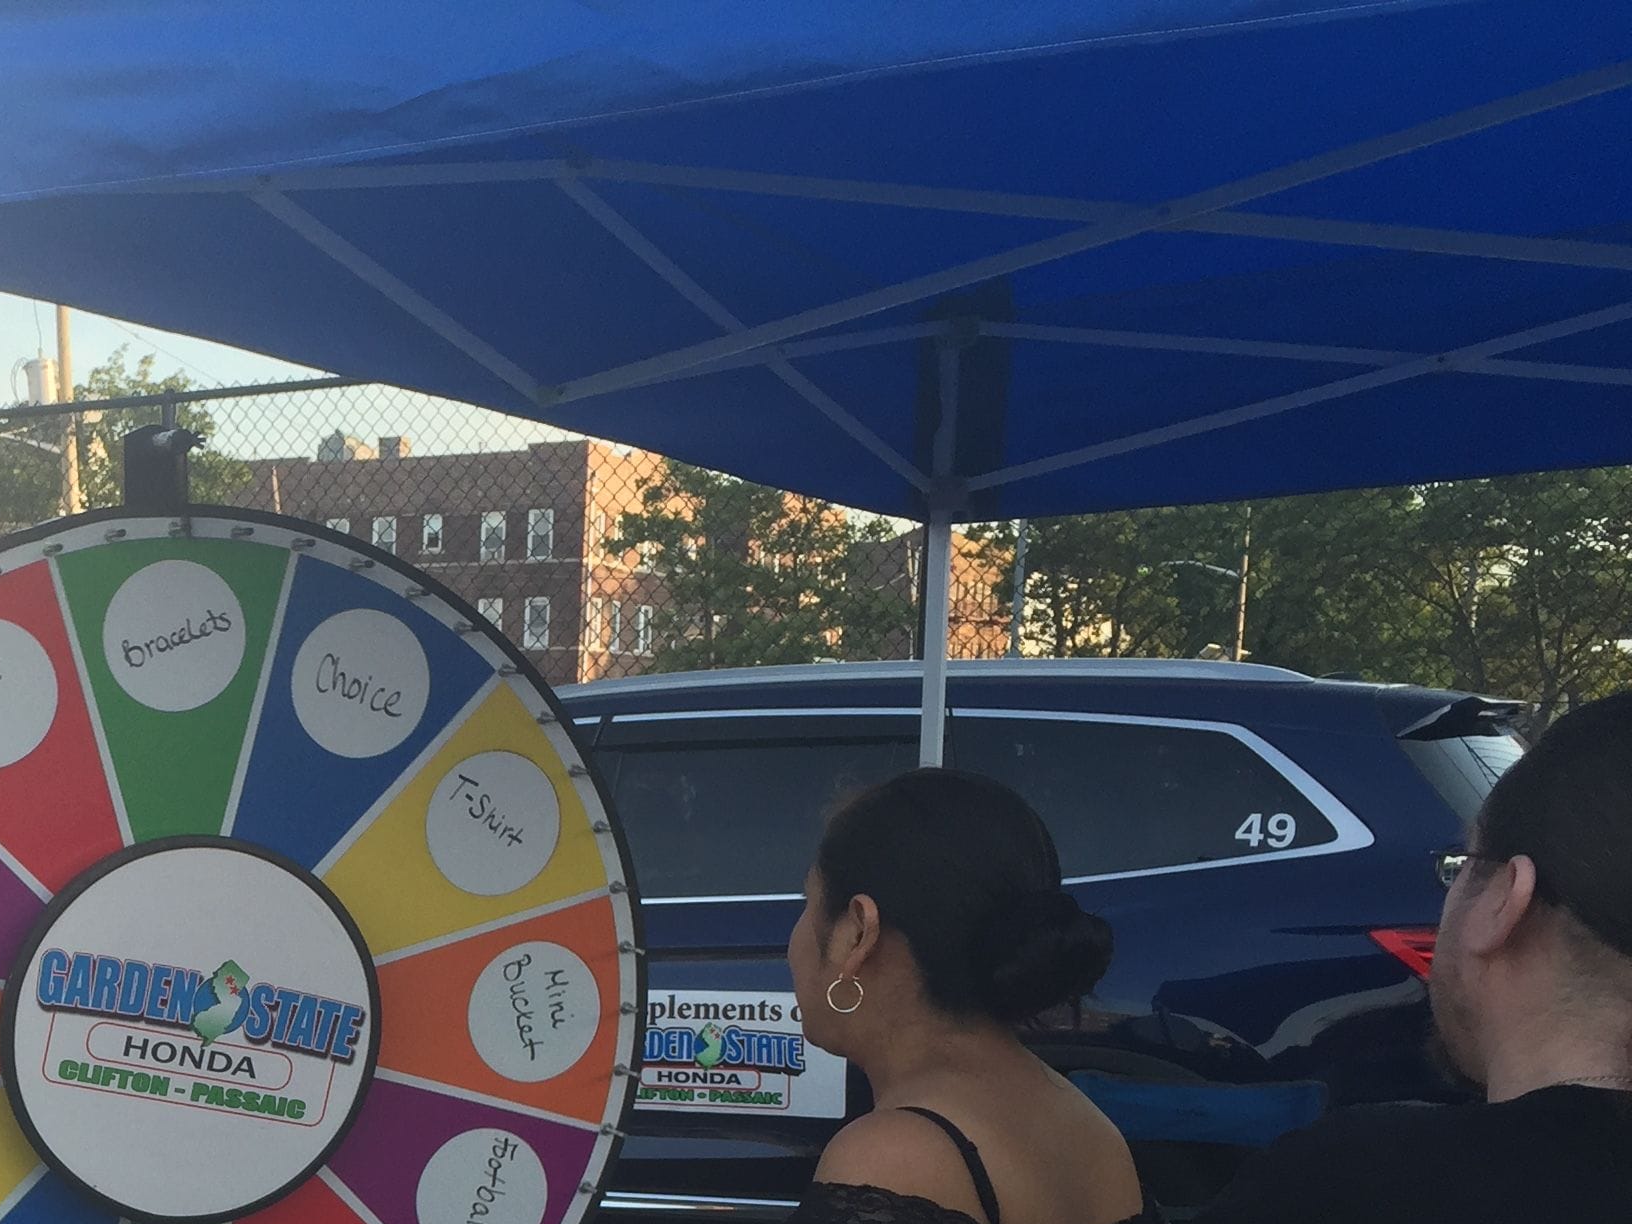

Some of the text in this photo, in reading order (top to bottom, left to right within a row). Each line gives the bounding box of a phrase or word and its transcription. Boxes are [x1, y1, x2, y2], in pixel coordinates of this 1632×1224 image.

[121, 609, 232, 668] Bracelets
[316, 653, 402, 718] Choice
[449, 773, 522, 847] T-Shirt
[1235, 812, 1296, 848] 49
[37, 948, 363, 1061] GARDEN STATE
[503, 953, 544, 1061] Bucket
[544, 969, 575, 1030] Mini
[647, 993, 782, 1026] plements
[123, 1035, 257, 1079] HONDA
[643, 1025, 805, 1070] DEN STATE
[58, 1060, 170, 1097] CLIFTON
[190, 1082, 307, 1120] PASSAIC
[637, 1087, 695, 1102] IFTON
[709, 1090, 783, 1106] PASSAIC
[657, 1070, 742, 1086] HONDA
